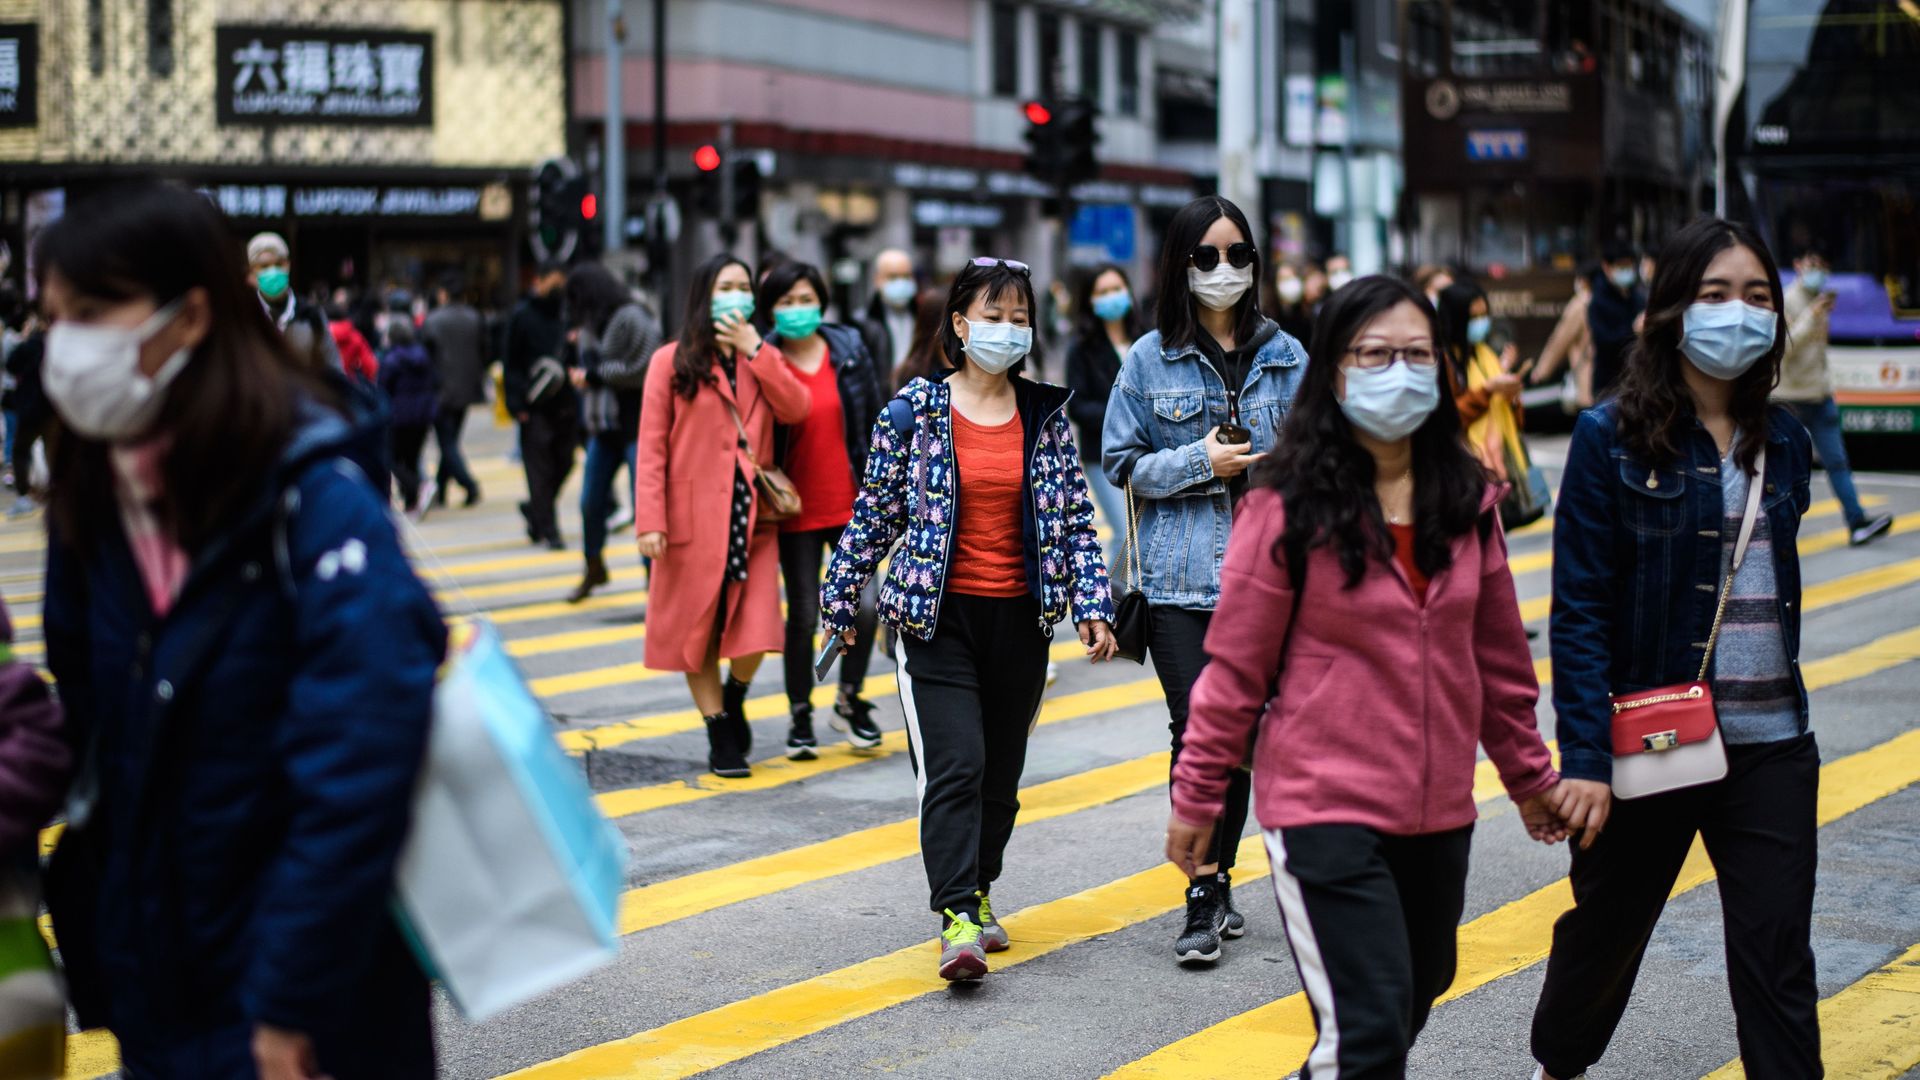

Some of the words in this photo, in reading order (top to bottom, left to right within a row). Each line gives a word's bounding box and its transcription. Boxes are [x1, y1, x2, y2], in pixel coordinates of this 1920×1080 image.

[233, 39, 423, 95] 六福珠寶
[212, 185, 287, 216] 福珠寶
